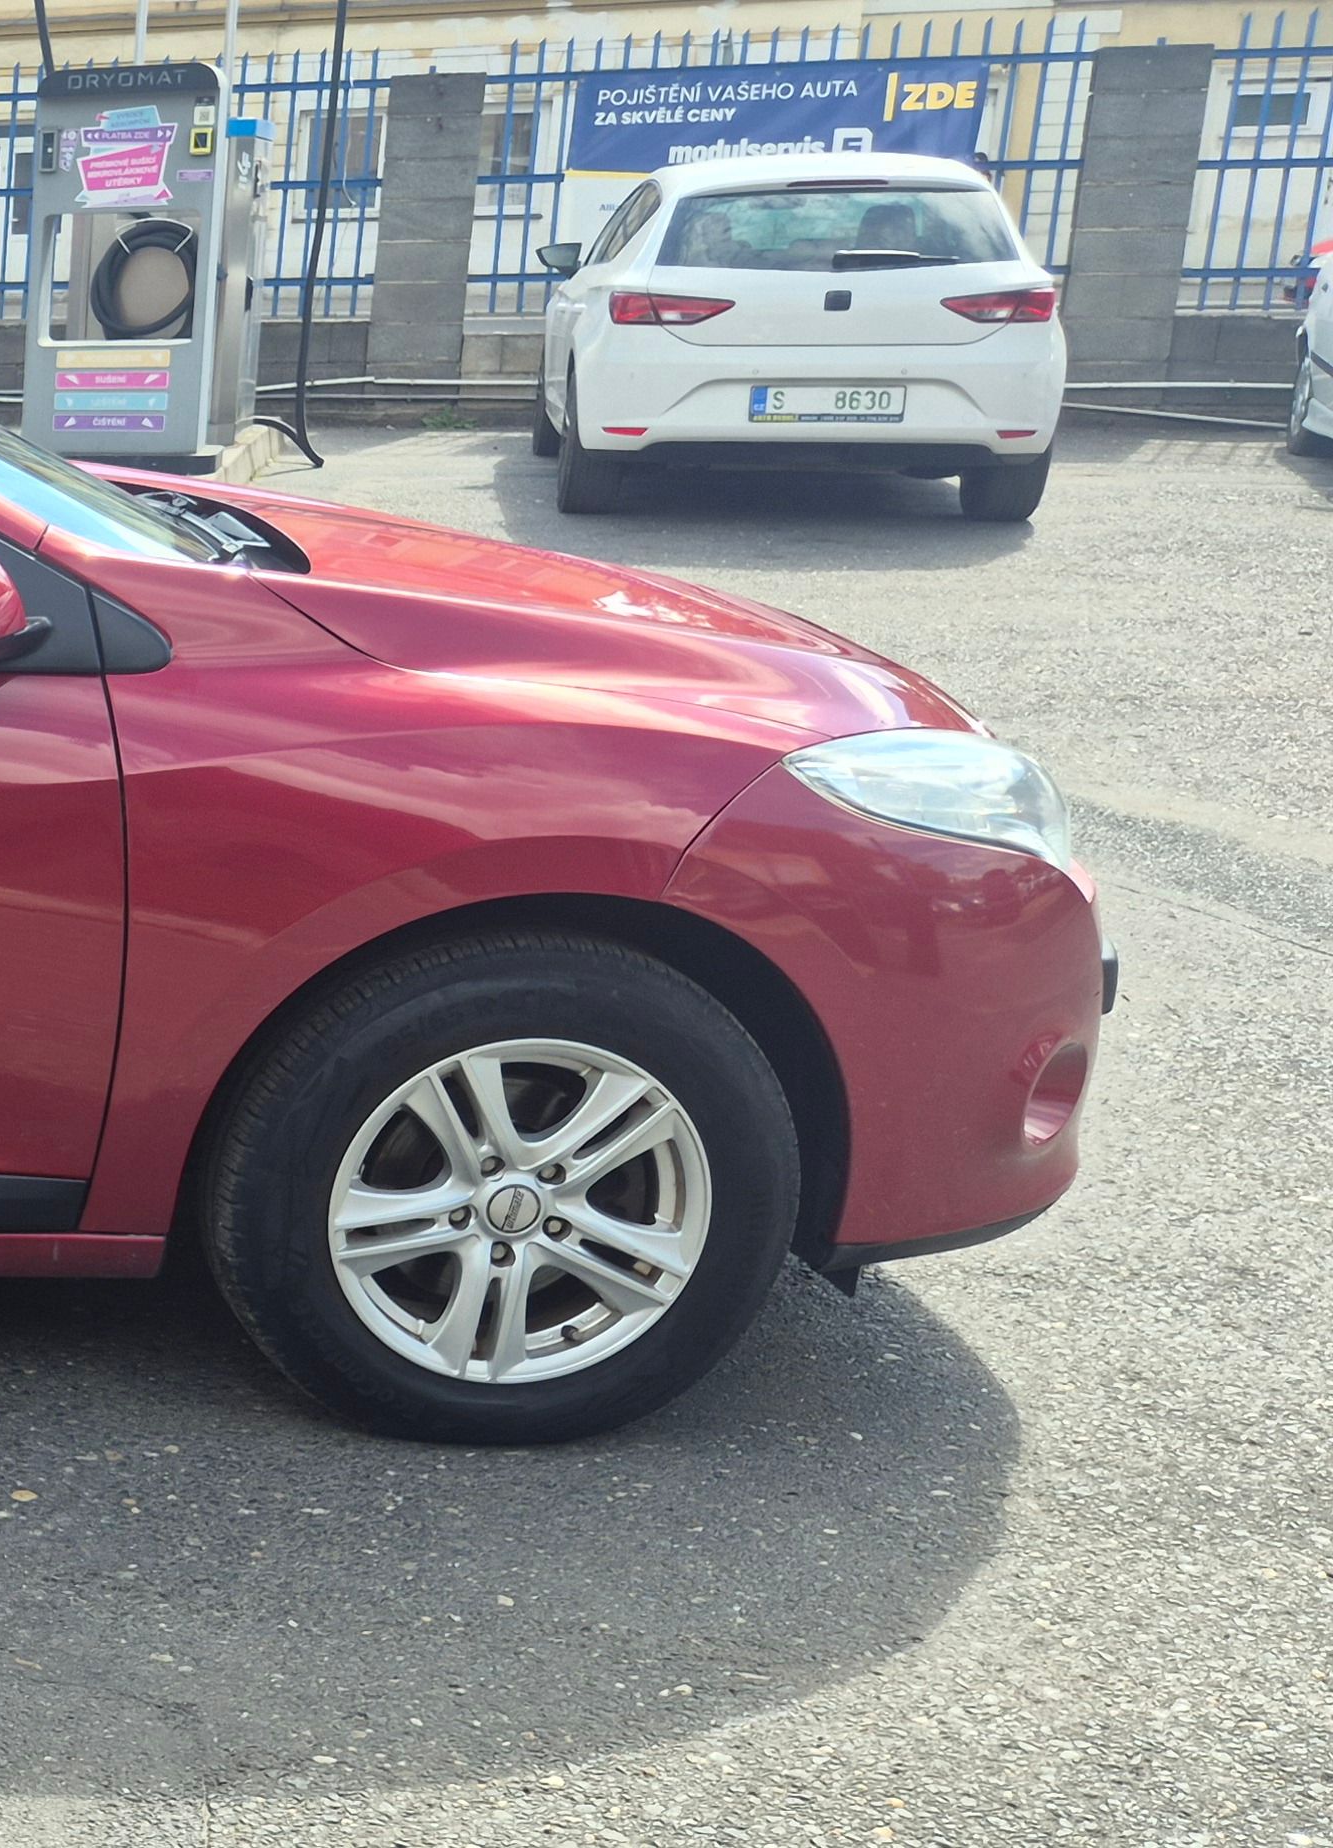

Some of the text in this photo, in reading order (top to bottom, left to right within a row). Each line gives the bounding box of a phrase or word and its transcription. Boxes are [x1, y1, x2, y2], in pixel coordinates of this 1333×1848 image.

[67, 69, 187, 90] DRYOMAT
[598, 78, 858, 106] POJIŠTĚNÍ VAŠEHO AUTA
[900, 80, 978, 111] ZDE
[594, 105, 737, 126] ZA SKVĚLÉ CENY
[101, 131, 150, 140] PLATBA ZDE
[668, 135, 826, 164] modulservis
[835, 390, 891, 411] 8630
[92, 417, 127, 426] ČIŠTĚNÍ
